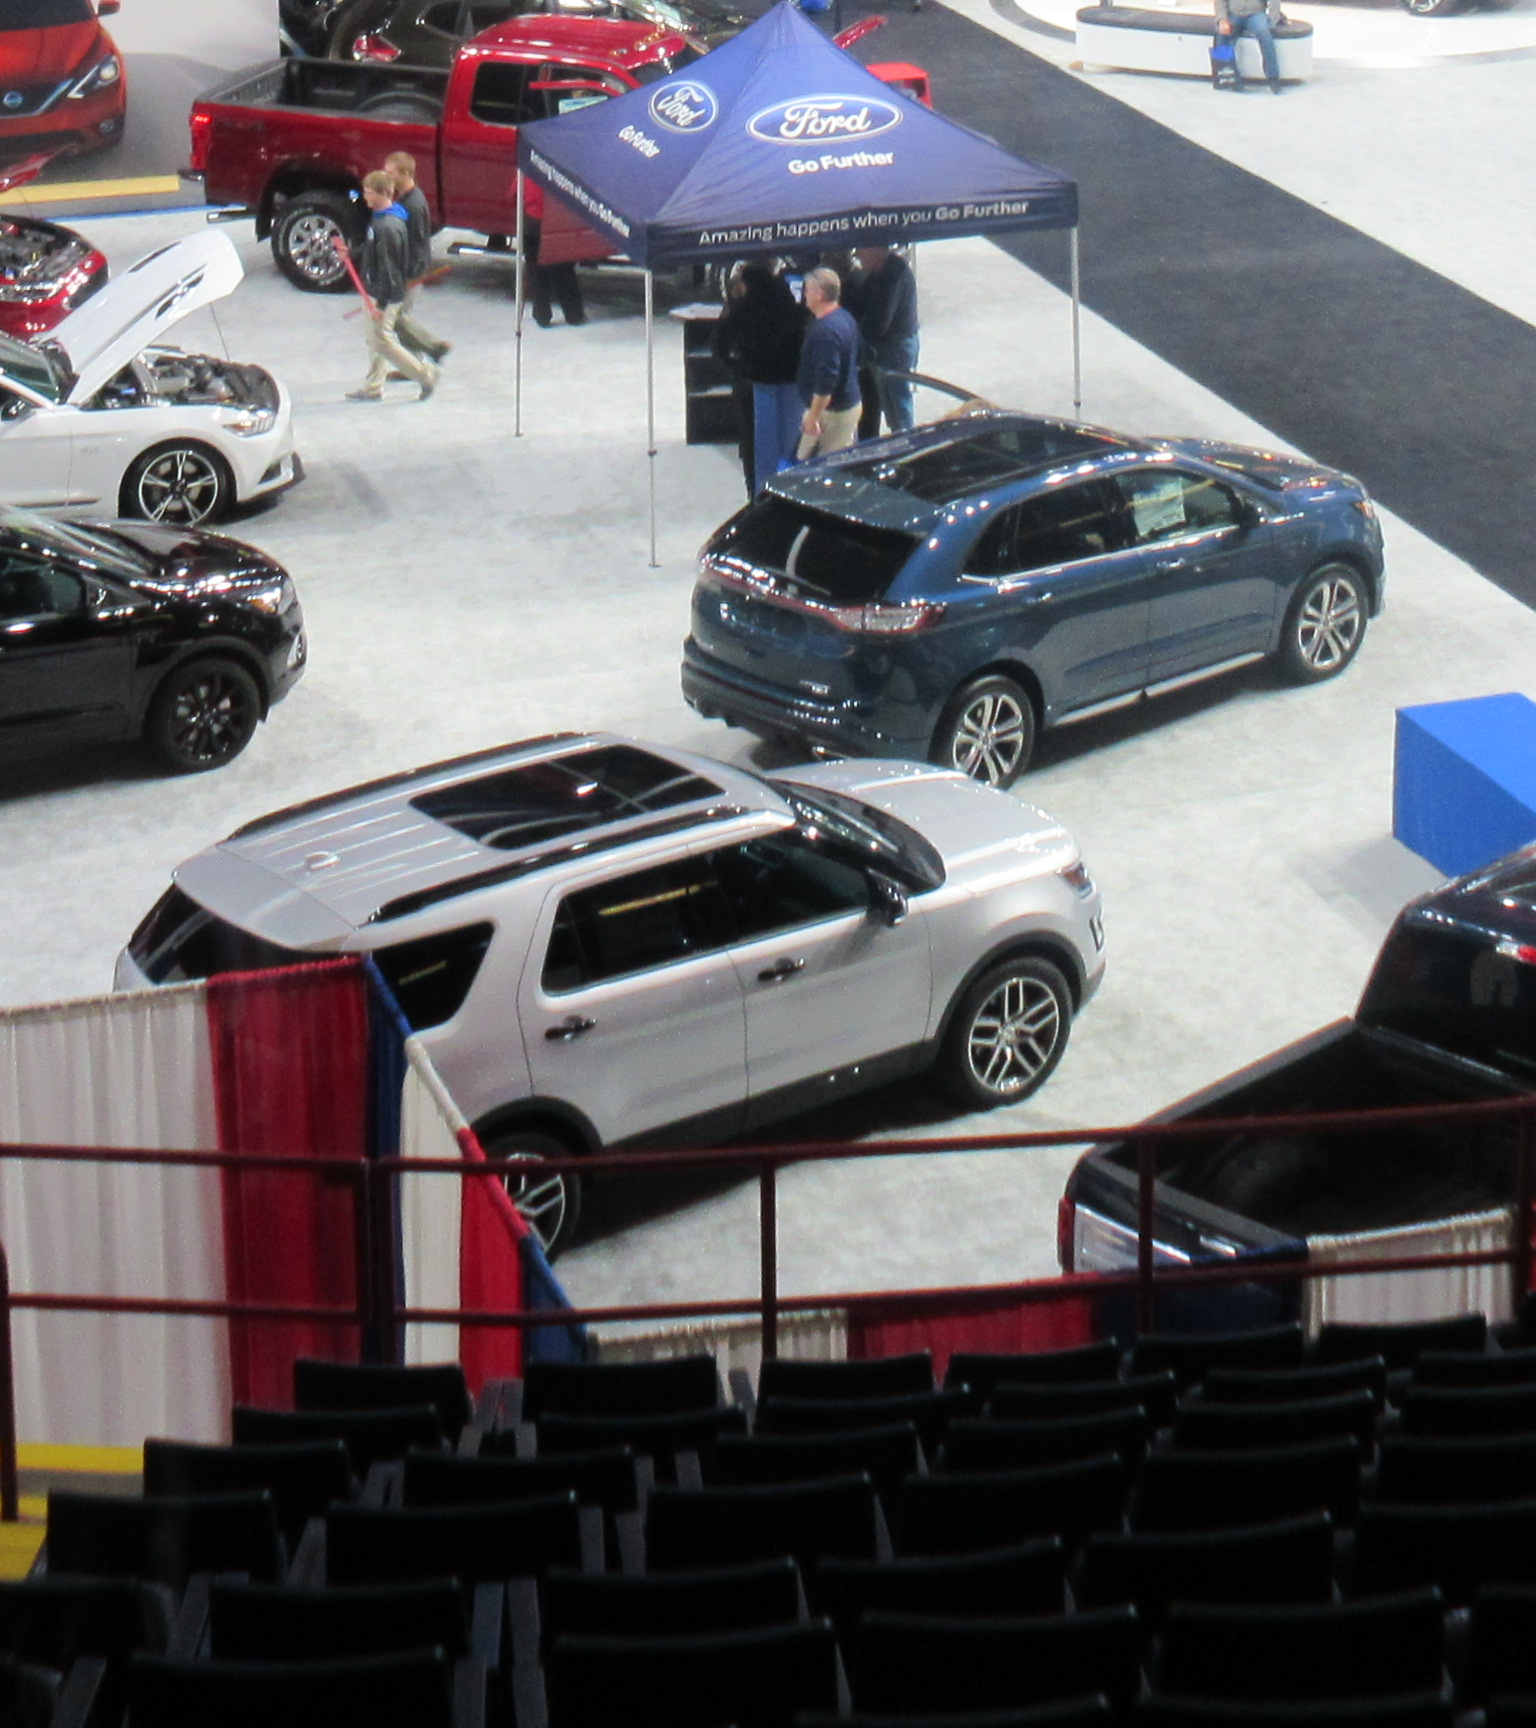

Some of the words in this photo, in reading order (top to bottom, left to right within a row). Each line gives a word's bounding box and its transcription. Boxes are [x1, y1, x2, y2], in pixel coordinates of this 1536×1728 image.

[656, 85, 706, 127] Ford
[778, 101, 873, 138] Ford
[632, 132, 661, 159] Further
[787, 159, 818, 175] Go
[820, 150, 895, 171] Further
[698, 224, 774, 247] Amazing
[776, 217, 850, 240] happens
[852, 209, 899, 229] when
[901, 209, 932, 227] you
[934, 206, 961, 221] Go
[962, 200, 1030, 218] Further
